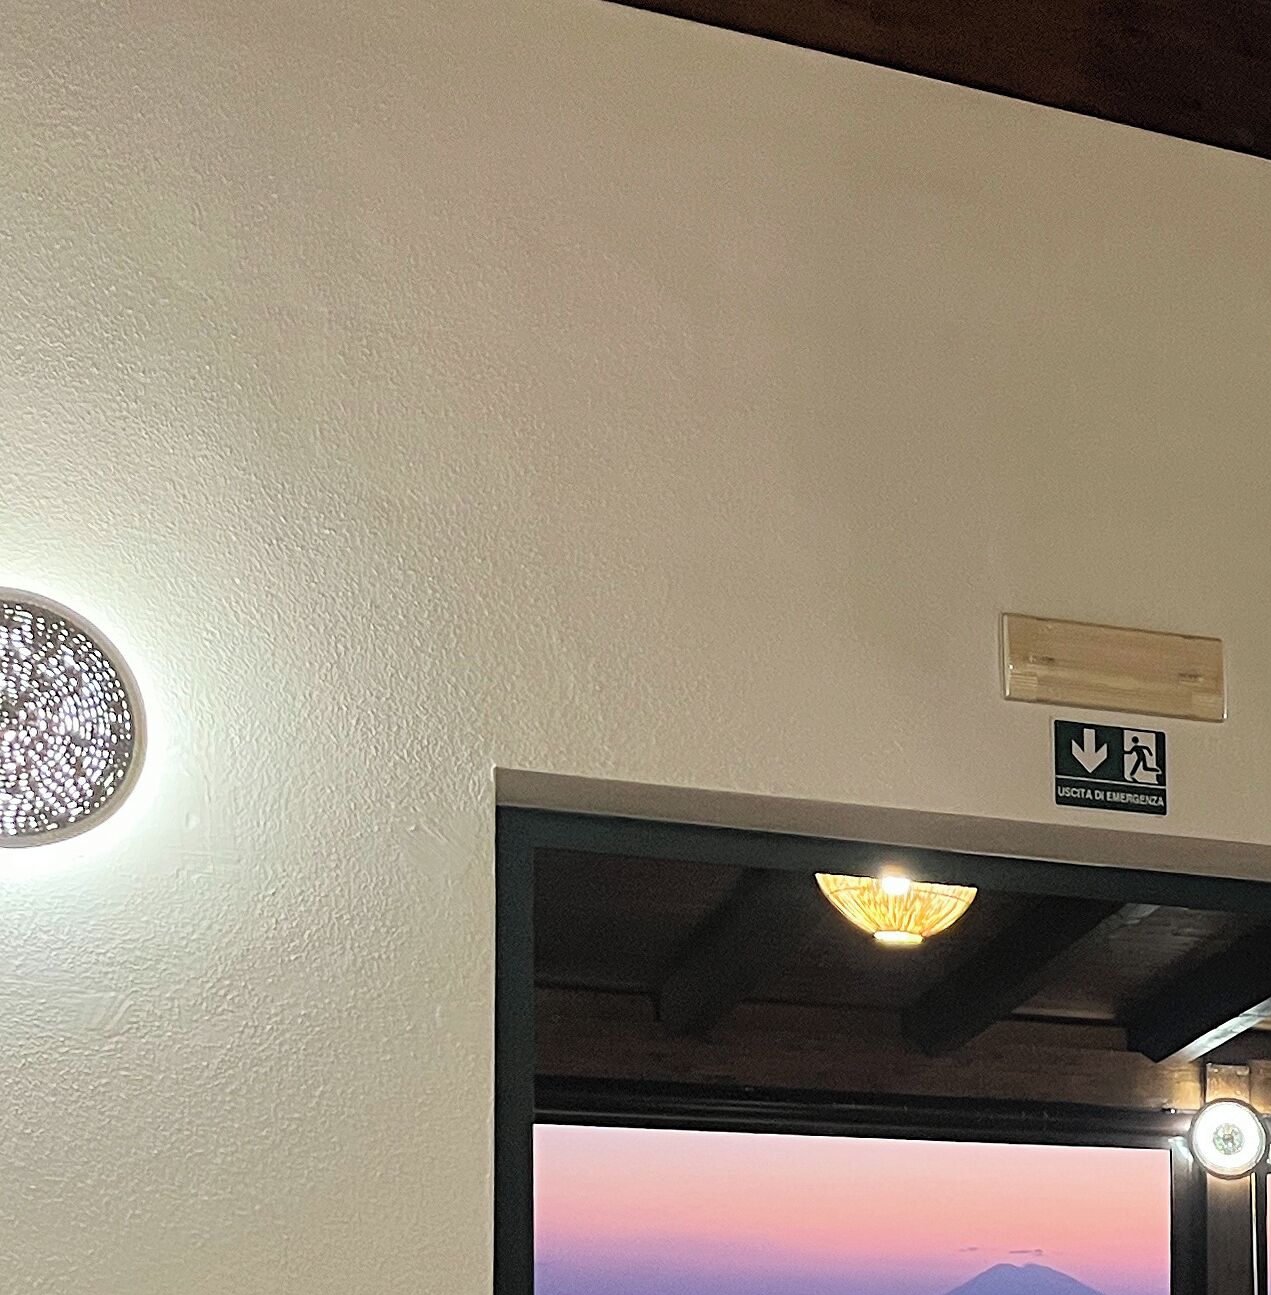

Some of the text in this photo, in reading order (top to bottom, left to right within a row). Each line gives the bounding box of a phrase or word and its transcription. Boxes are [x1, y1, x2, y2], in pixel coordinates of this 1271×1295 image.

[1057, 786, 1165, 807] USCITA DI EMERGENZA
